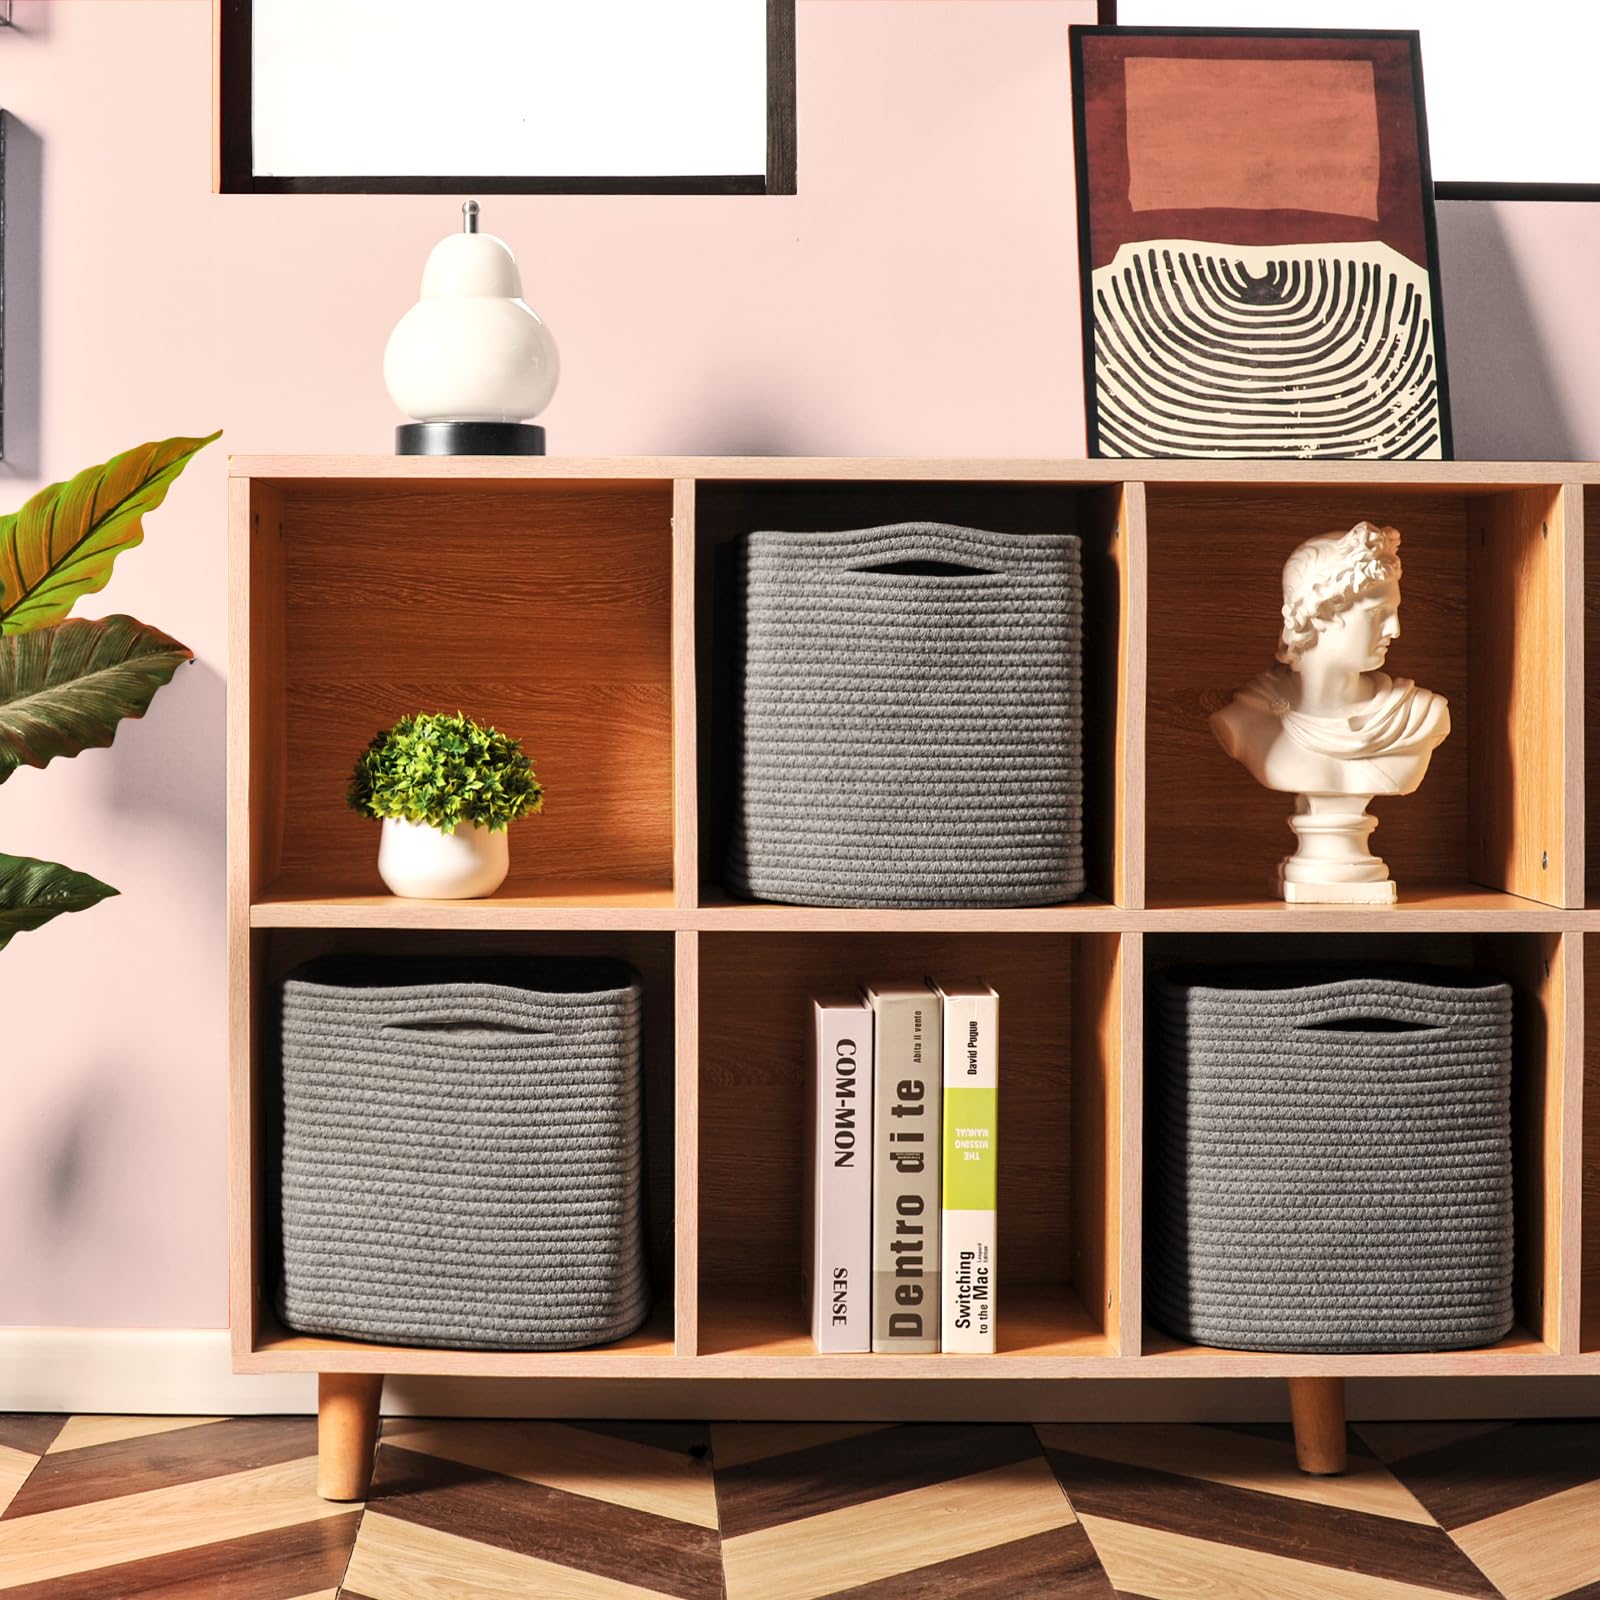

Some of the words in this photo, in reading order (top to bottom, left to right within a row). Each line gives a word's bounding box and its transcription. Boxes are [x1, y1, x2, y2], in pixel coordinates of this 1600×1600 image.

[914, 1010, 922, 1033] vento
[967, 1021, 978, 1048] Pogue
[913, 1043, 922, 1063] Abita
[967, 1048, 978, 1075] David
[835, 1038, 857, 1168] COM-MON
[891, 1080, 924, 1118] te
[955, 1128, 988, 1137] MANUAL
[963, 1151, 981, 1161] THE
[889, 1195, 924, 1337] Dentro
[832, 1267, 848, 1326] SENSE
[955, 1251, 975, 1329] Switching
[973, 1267, 989, 1300] Mac
[977, 1304, 988, 1320] the
[979, 1323, 988, 1334] to
